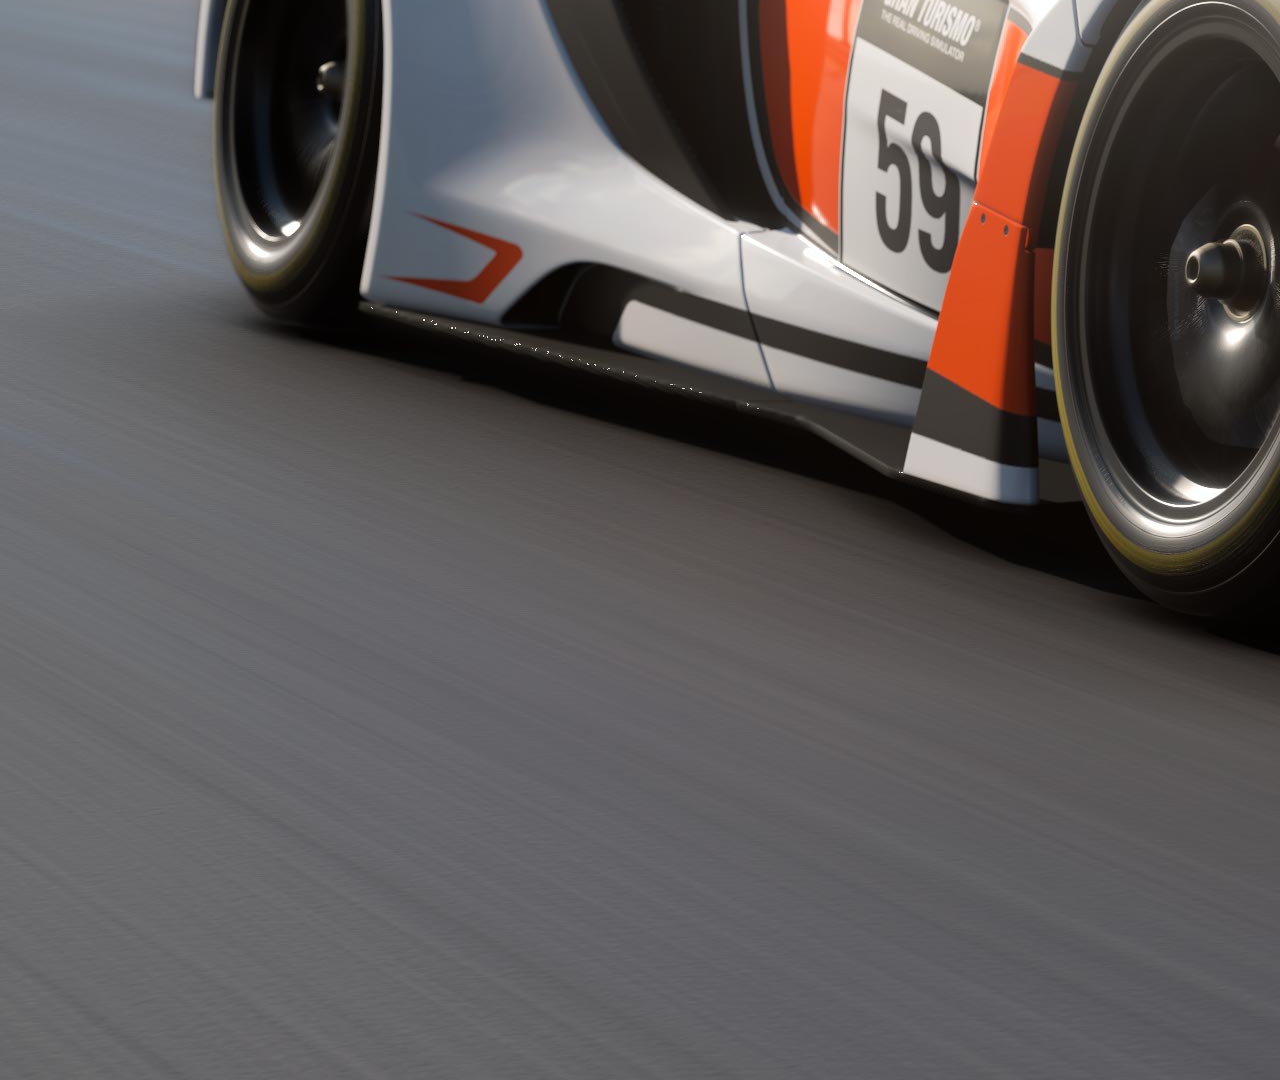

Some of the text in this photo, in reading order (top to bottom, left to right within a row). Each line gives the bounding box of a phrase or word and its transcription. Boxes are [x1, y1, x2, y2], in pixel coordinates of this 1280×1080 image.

[881, 9, 966, 64] THE REAL DRIVING SIMULATOR
[875, 88, 961, 274] 59
